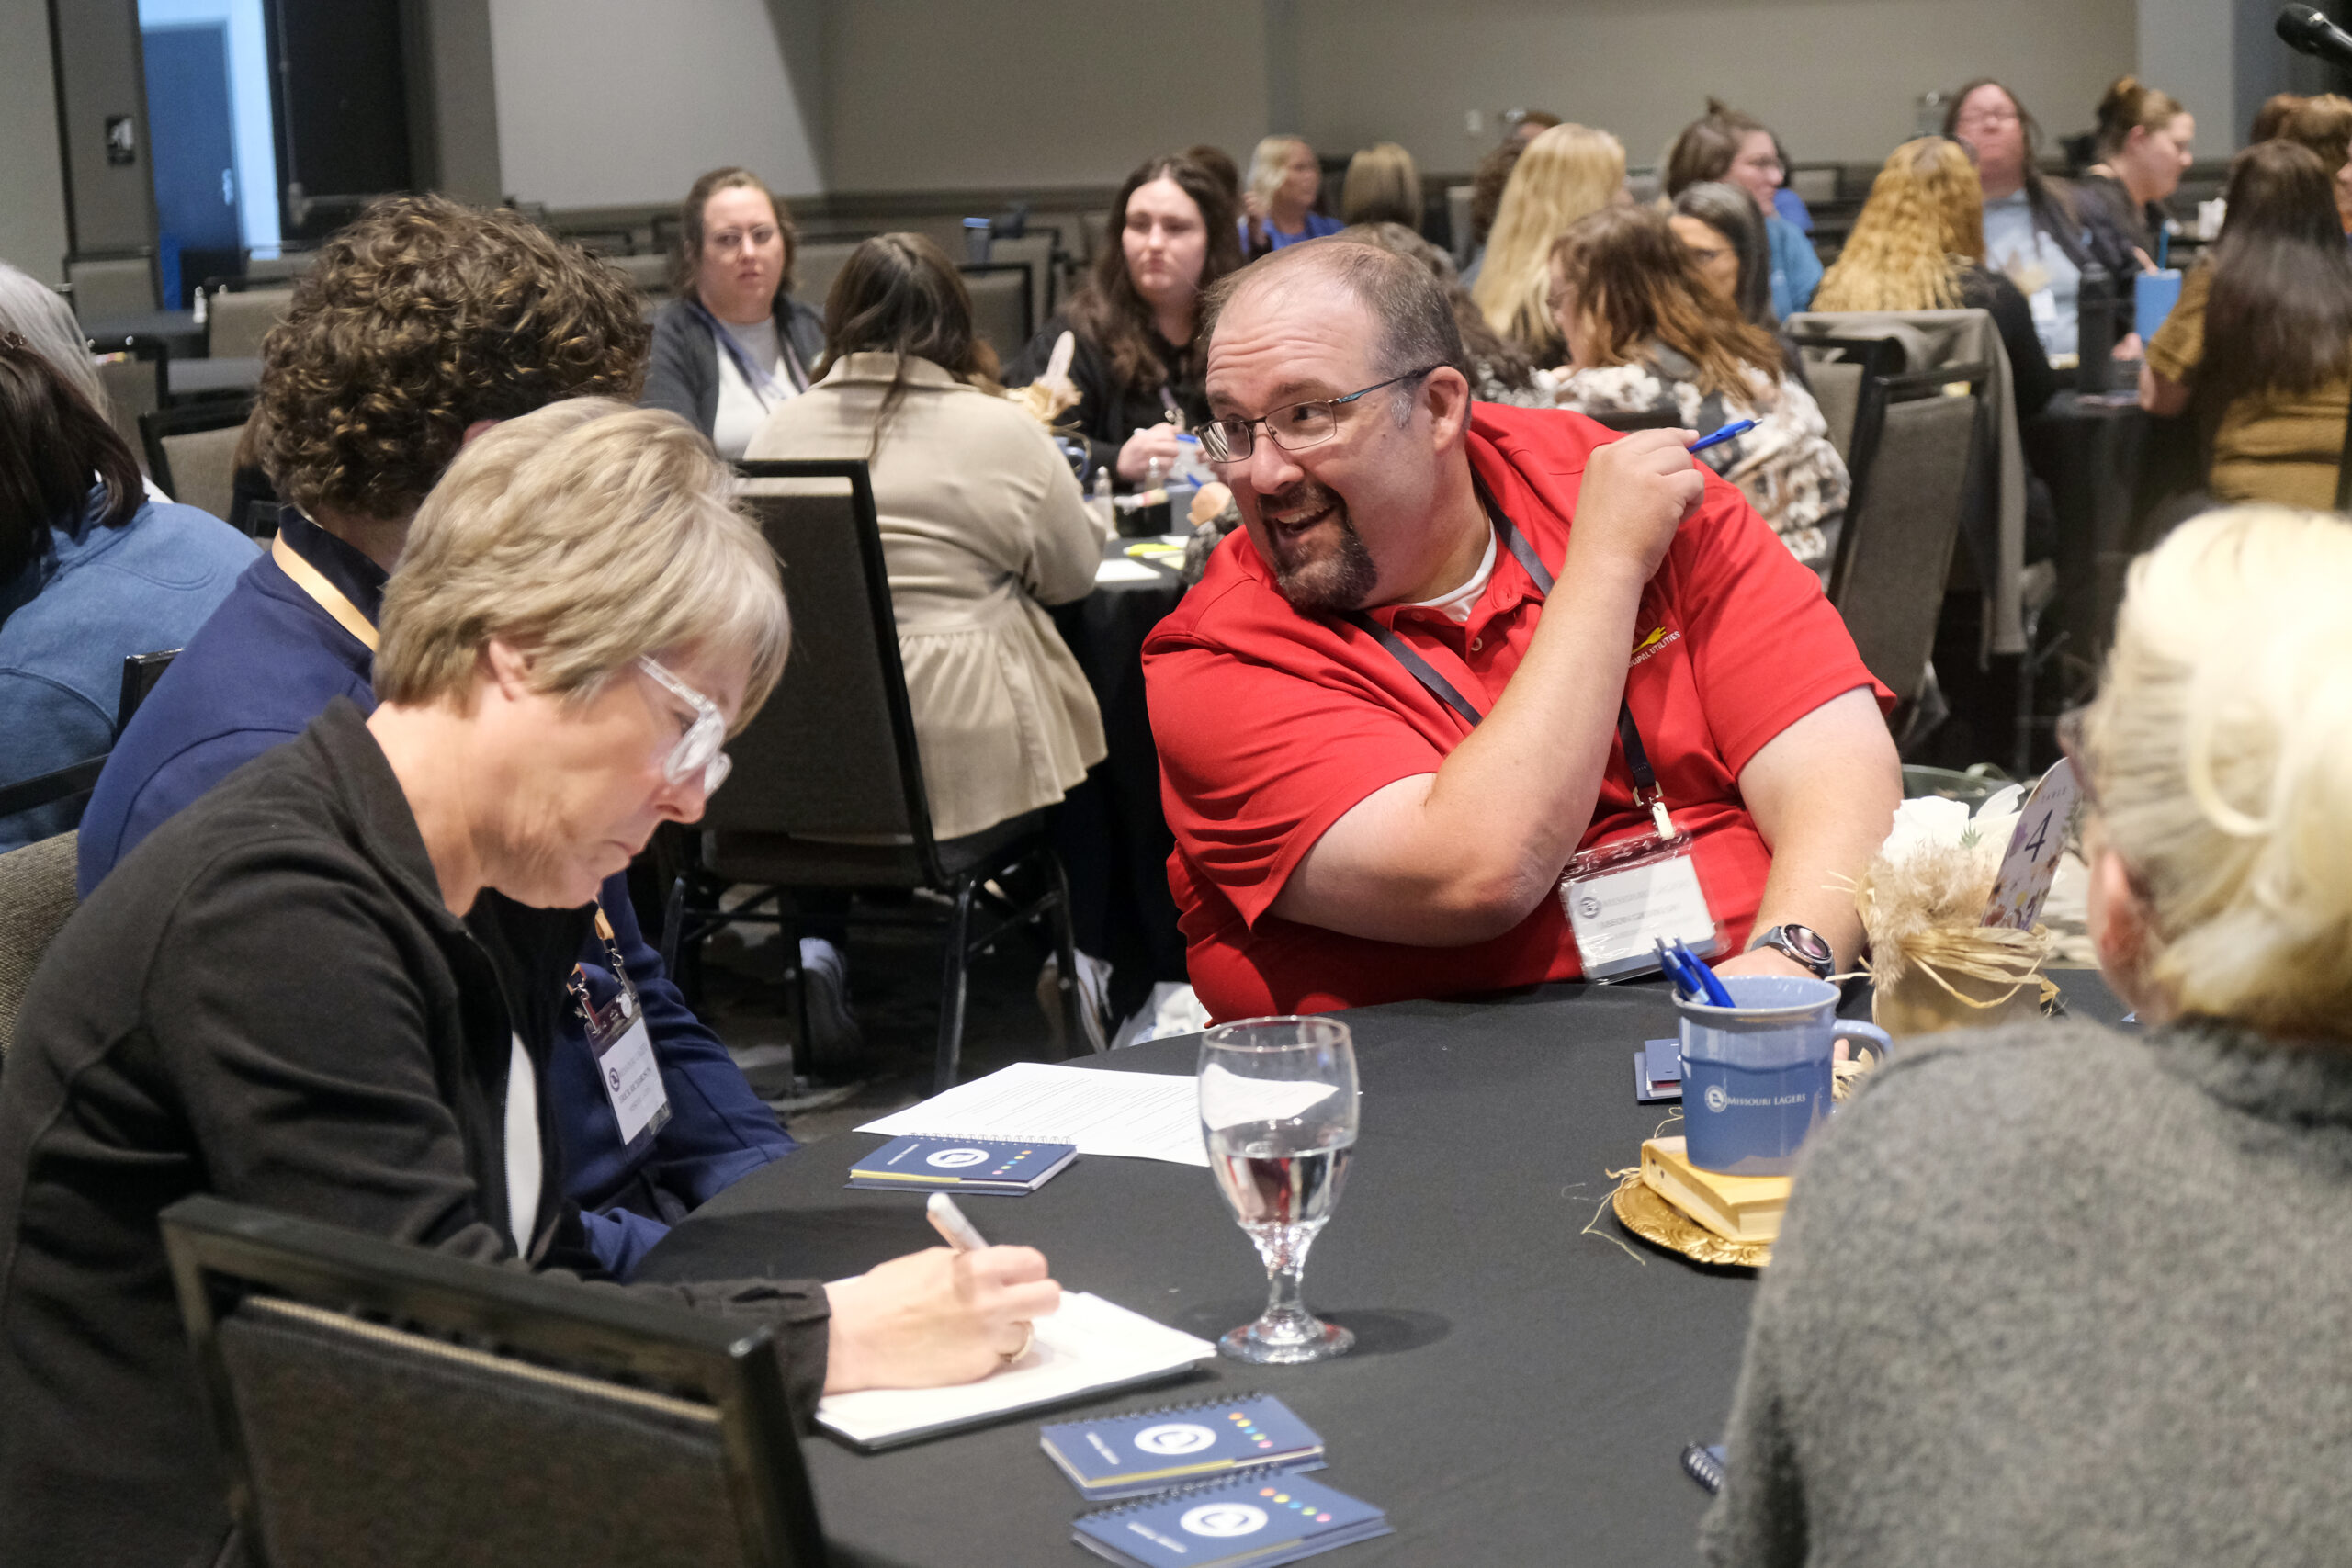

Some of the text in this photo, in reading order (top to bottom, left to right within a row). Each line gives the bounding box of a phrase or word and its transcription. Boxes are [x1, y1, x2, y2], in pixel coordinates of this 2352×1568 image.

[1649, 631, 1680, 654] UTILITIES
[2041, 786, 2067, 804] TABLE
[2024, 809, 2053, 863] 4
[1727, 1093, 1806, 1106] MISSOURI LAGERS
